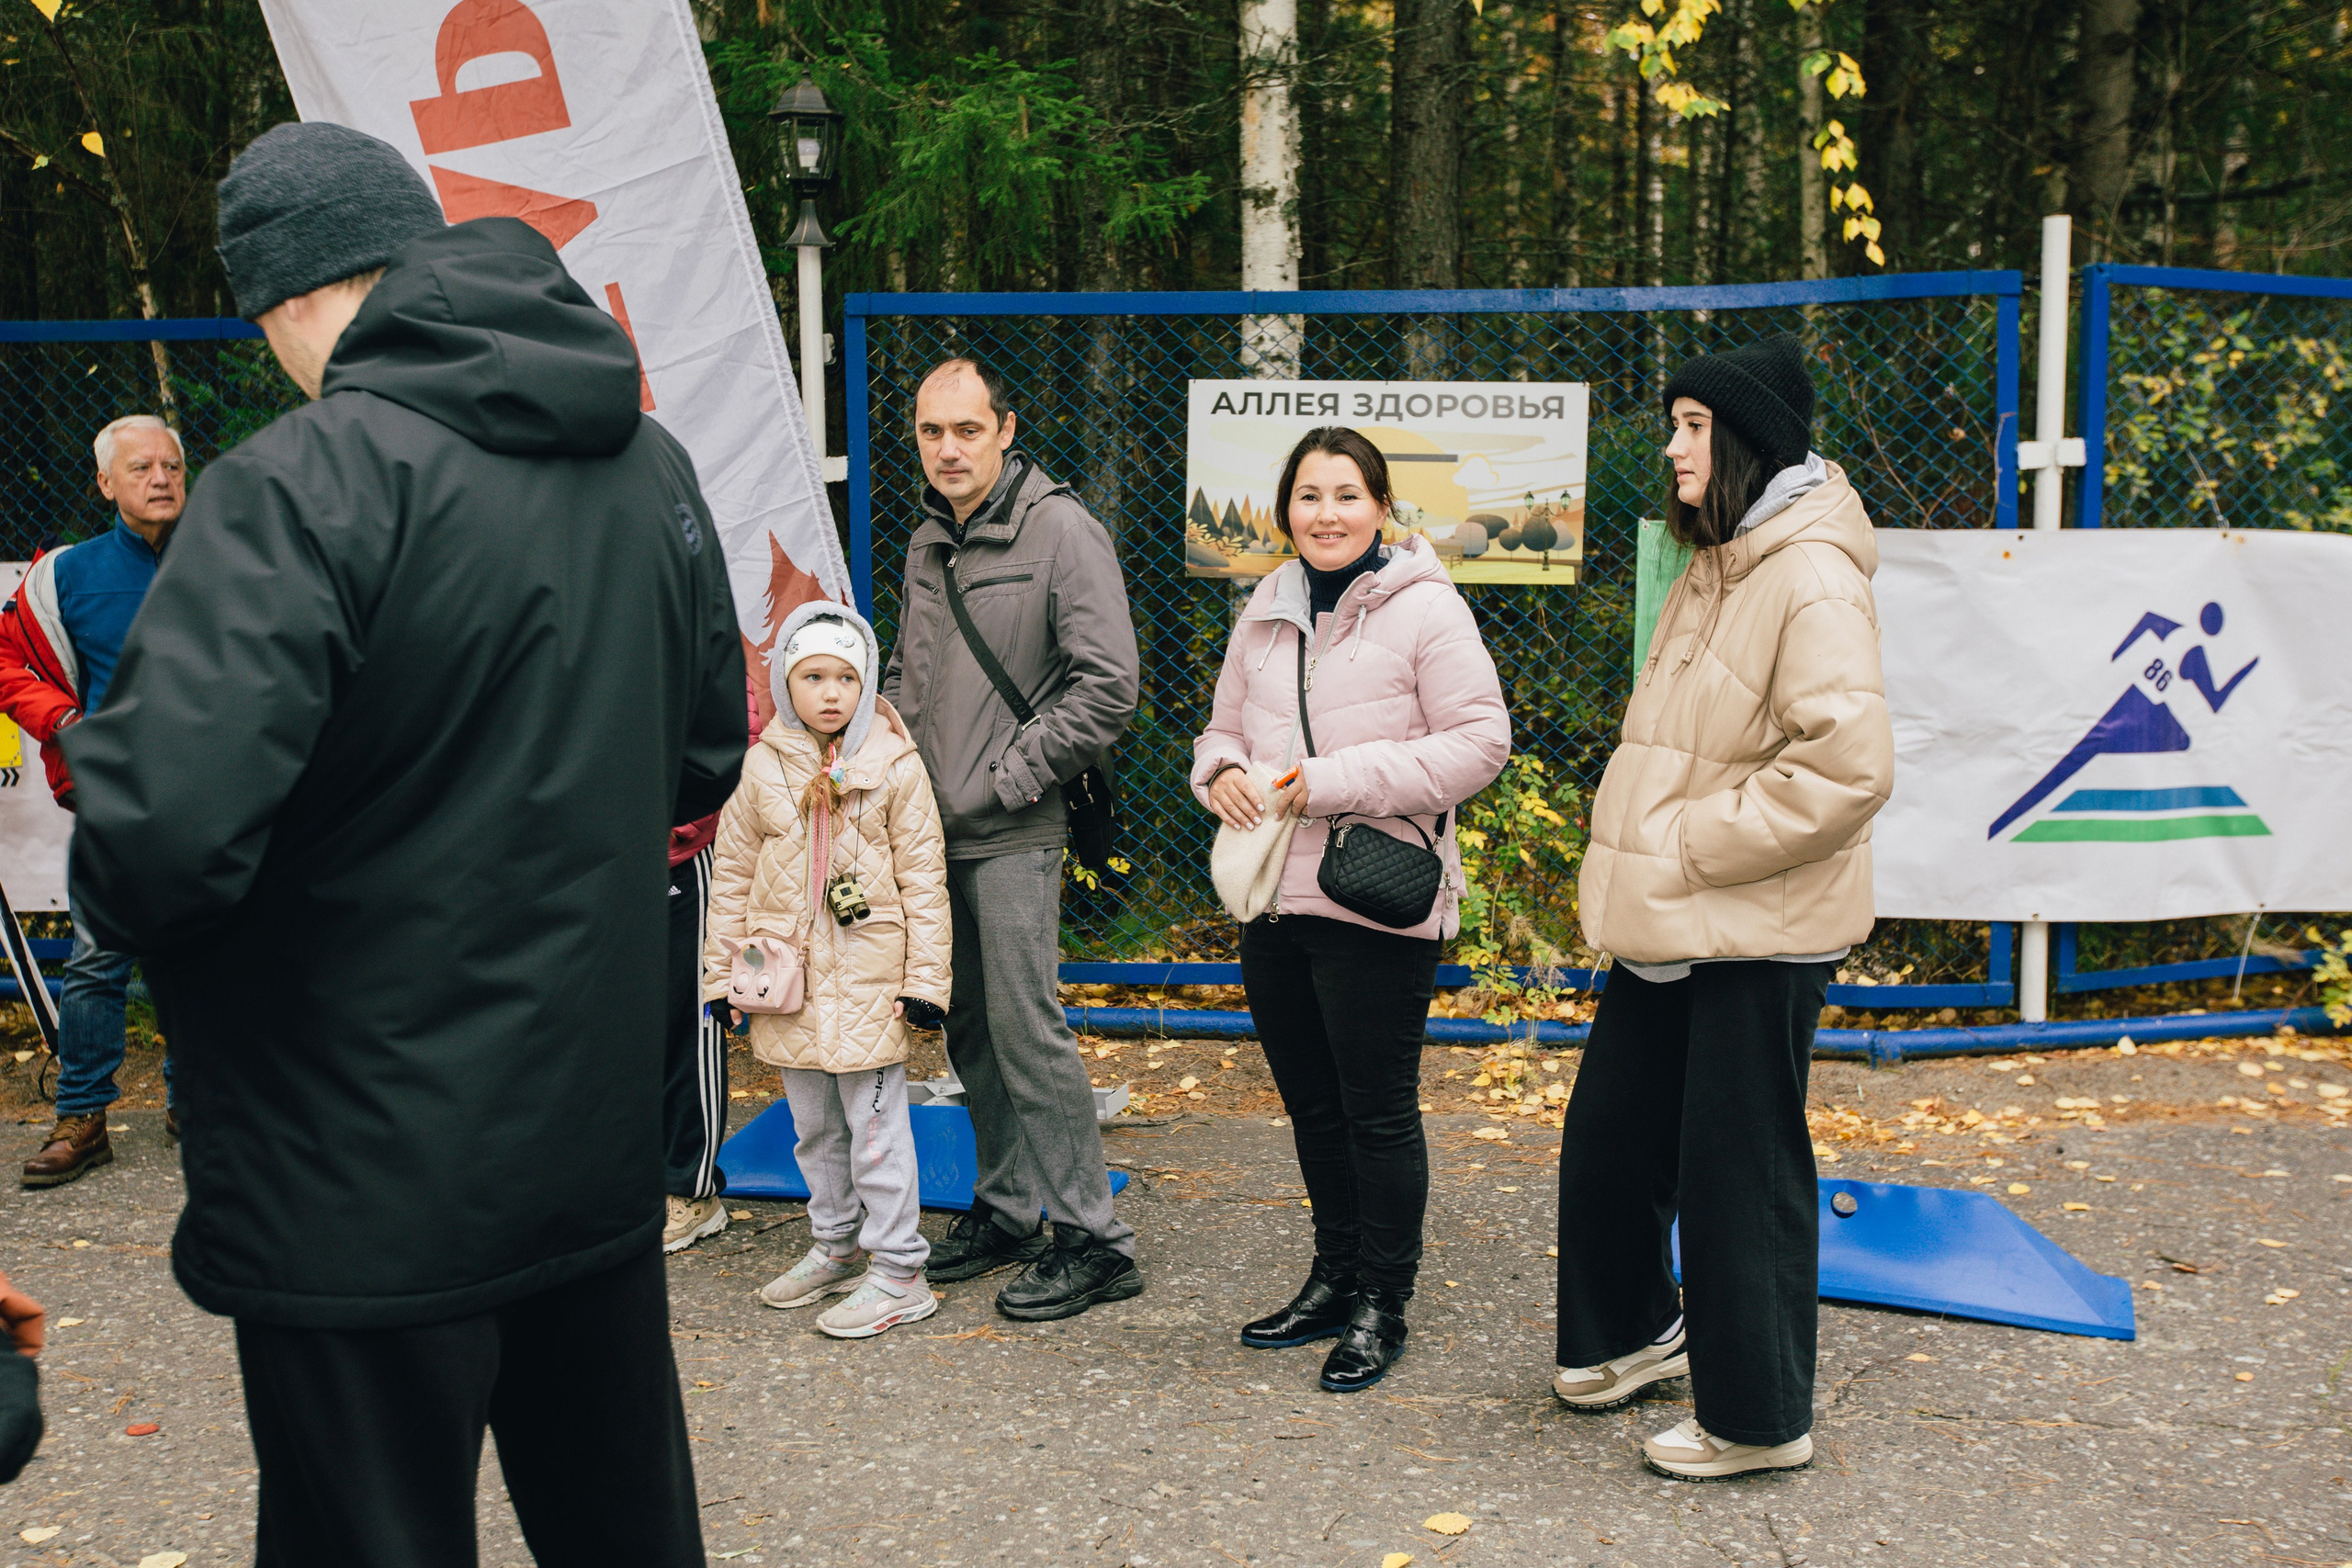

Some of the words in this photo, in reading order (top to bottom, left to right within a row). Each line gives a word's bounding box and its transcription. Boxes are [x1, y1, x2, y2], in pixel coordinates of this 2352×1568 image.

[1210, 391, 1340, 416] АЛЛЕЯ
[1352, 393, 1566, 422] ЗДОРОВЬЯ
[2143, 658, 2172, 692] 86
